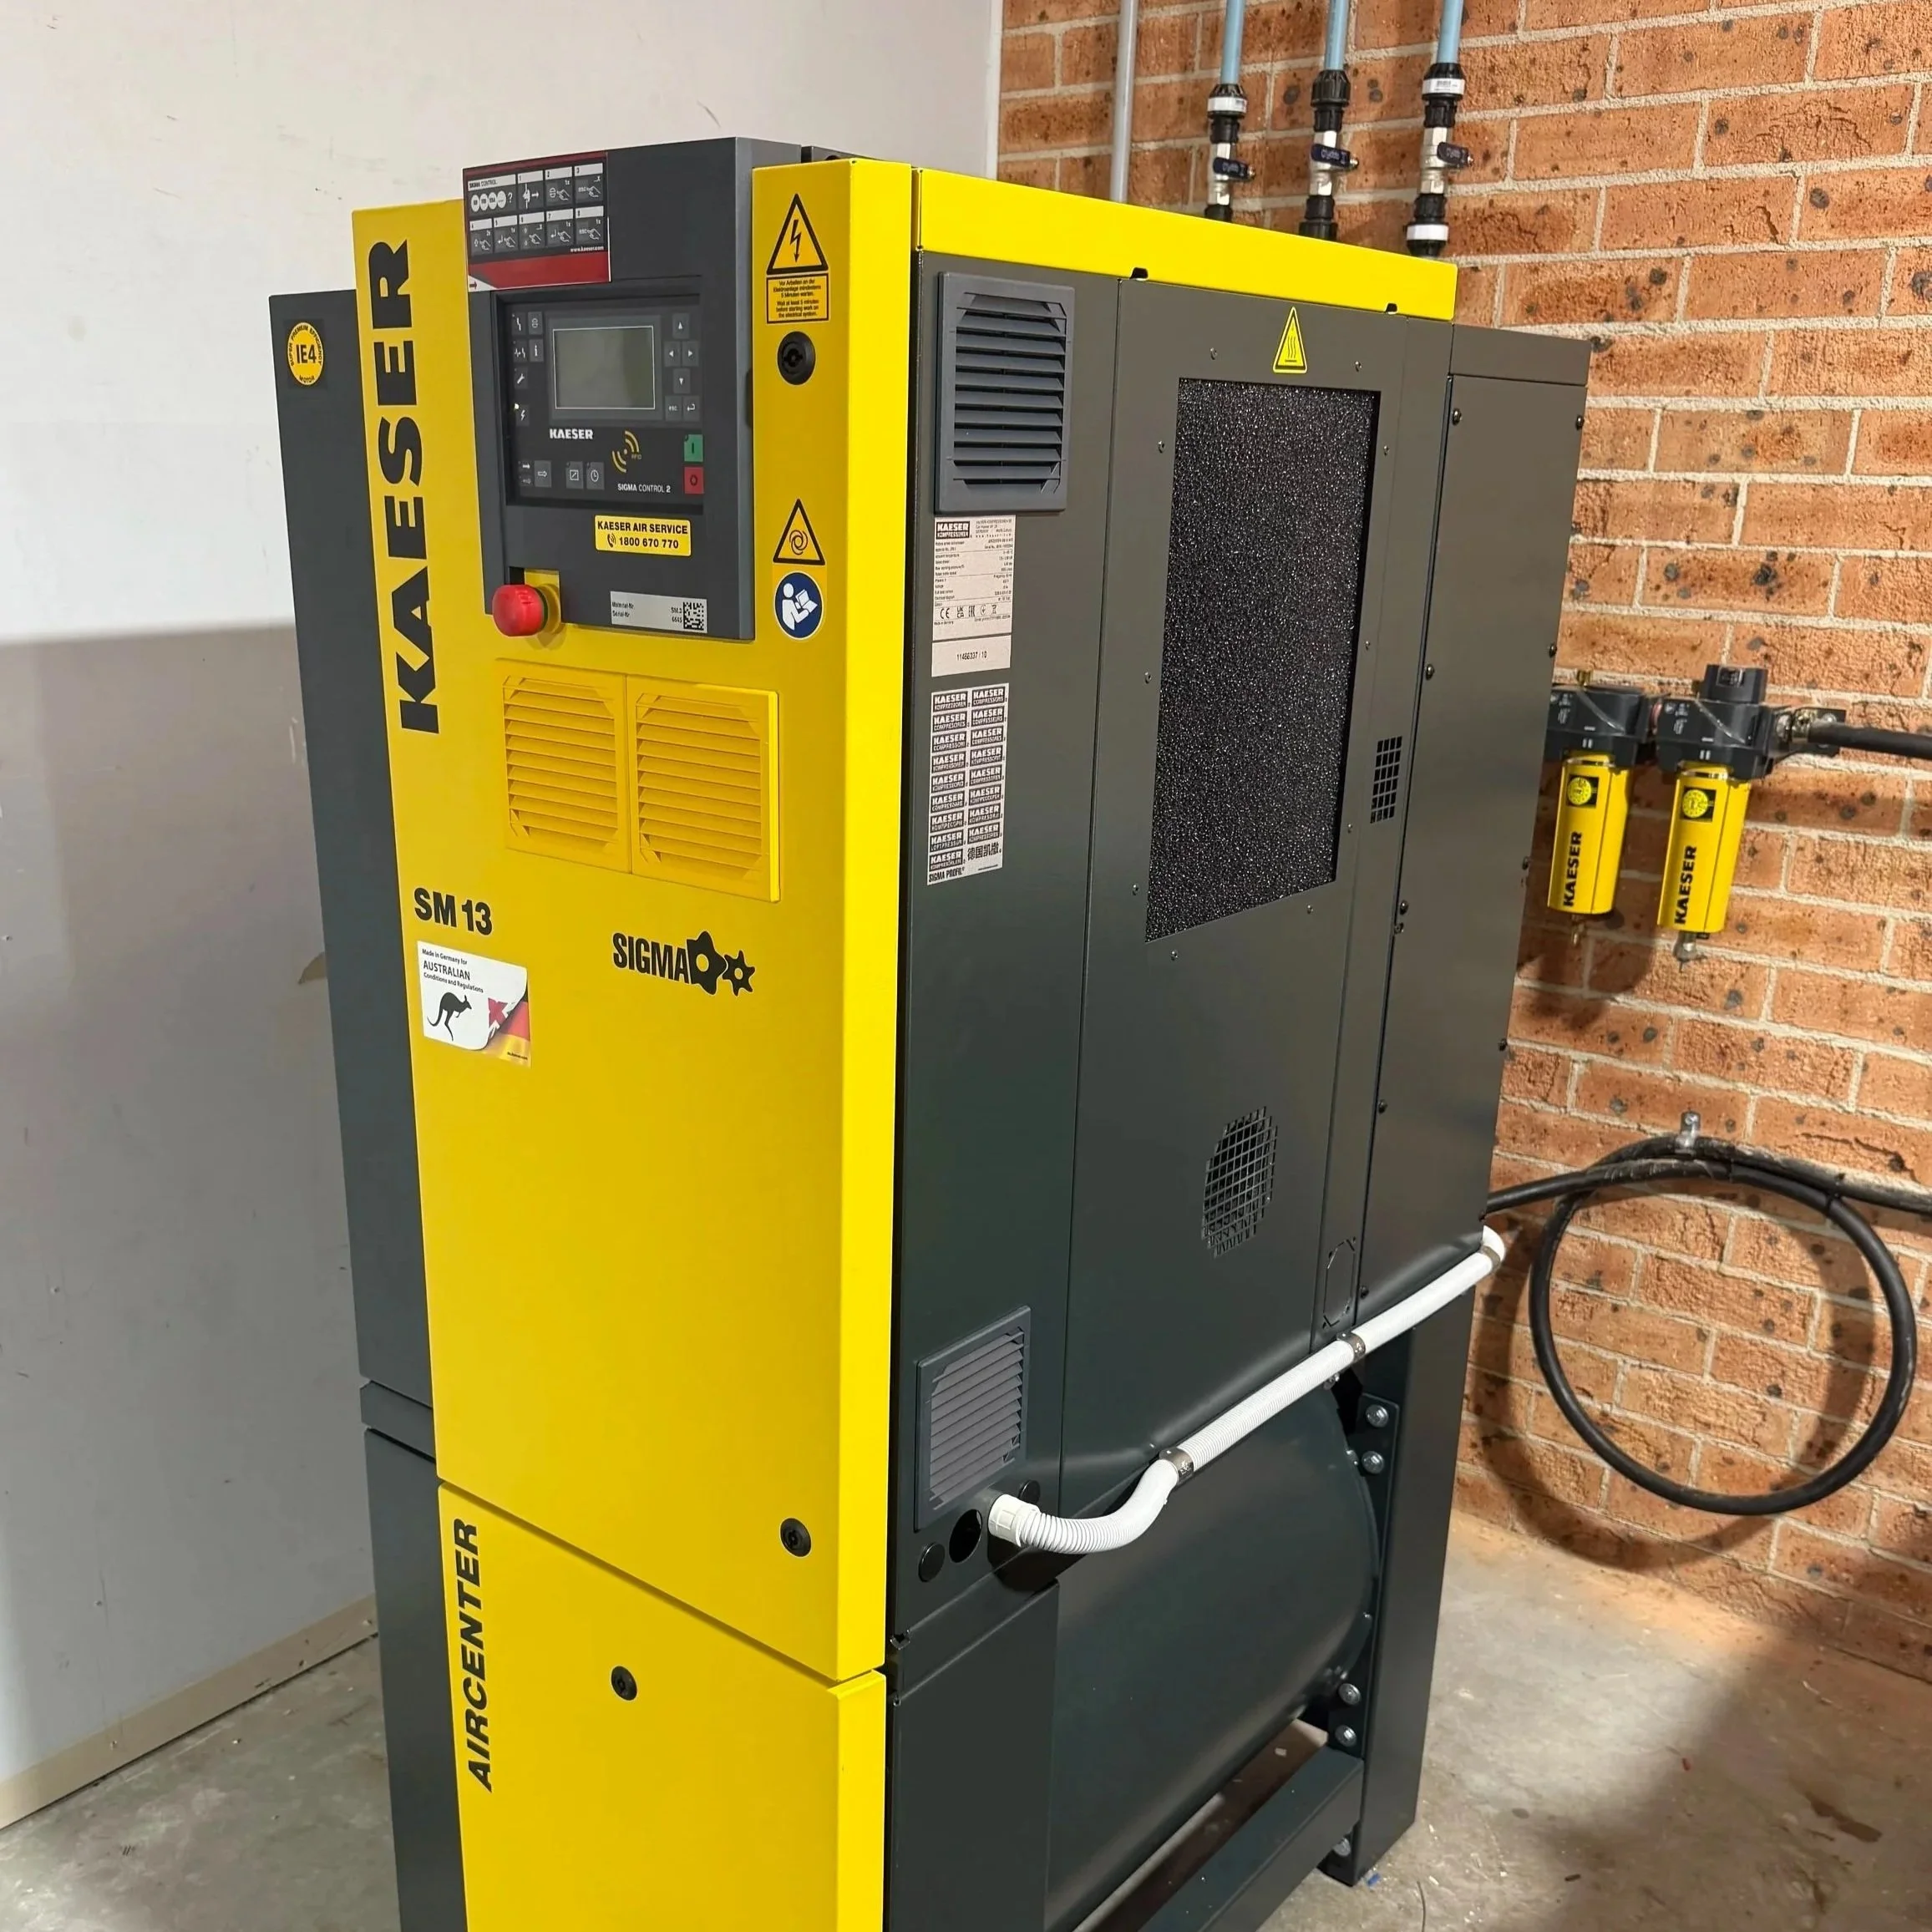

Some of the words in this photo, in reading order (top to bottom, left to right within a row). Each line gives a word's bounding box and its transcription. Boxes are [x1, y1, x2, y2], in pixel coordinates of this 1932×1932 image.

[296, 344, 317, 364] IE4
[550, 428, 594, 440] KAESER
[368, 239, 439, 733] KAESER
[617, 483, 637, 492] SIGMA
[638, 484, 665, 493] CONTROL
[666, 485, 671, 493] 2
[597, 520, 631, 532] KAESER
[633, 523, 648, 532] AIR
[649, 524, 689, 535] SERVICE
[937, 522, 969, 531] KAESER
[619, 537, 640, 547] 1800
[642, 538, 659, 548] 670
[662, 539, 679, 549] 770
[935, 693, 966, 704] KAESER
[974, 689, 1004, 699] KAESER
[934, 713, 965, 724] KAESER
[973, 708, 1002, 719] KAESER
[934, 733, 965, 744] KAESER
[972, 728, 1002, 739] KAESER
[933, 753, 964, 765] KAESER
[971, 748, 1001, 758] KAESER
[971, 767, 1000, 778] KAESER
[933, 773, 963, 785] KAESER
[970, 786, 1000, 798] KAESER
[932, 794, 963, 805] KAESER
[970, 805, 999, 817] KAESER
[932, 812, 963, 824] KAESER
[969, 824, 999, 836] KAESER
[931, 832, 962, 844] KAESER
[931, 852, 961, 864] KAESER
[1564, 831, 1583, 907] KAESER
[928, 870, 945, 882] SIGMA
[1675, 845, 1697, 924] KAESER
[414, 887, 457, 928] SM
[461, 899, 492, 936] 13
[422, 948, 434, 957] Made
[439, 953, 460, 965] Germany
[612, 932, 690, 984] SIGMA
[423, 960, 470, 981] AUSTRALIAN
[423, 972, 447, 984] Conditions
[457, 980, 484, 993] Regulations
[454, 1518, 492, 1793] AIRCENTER
